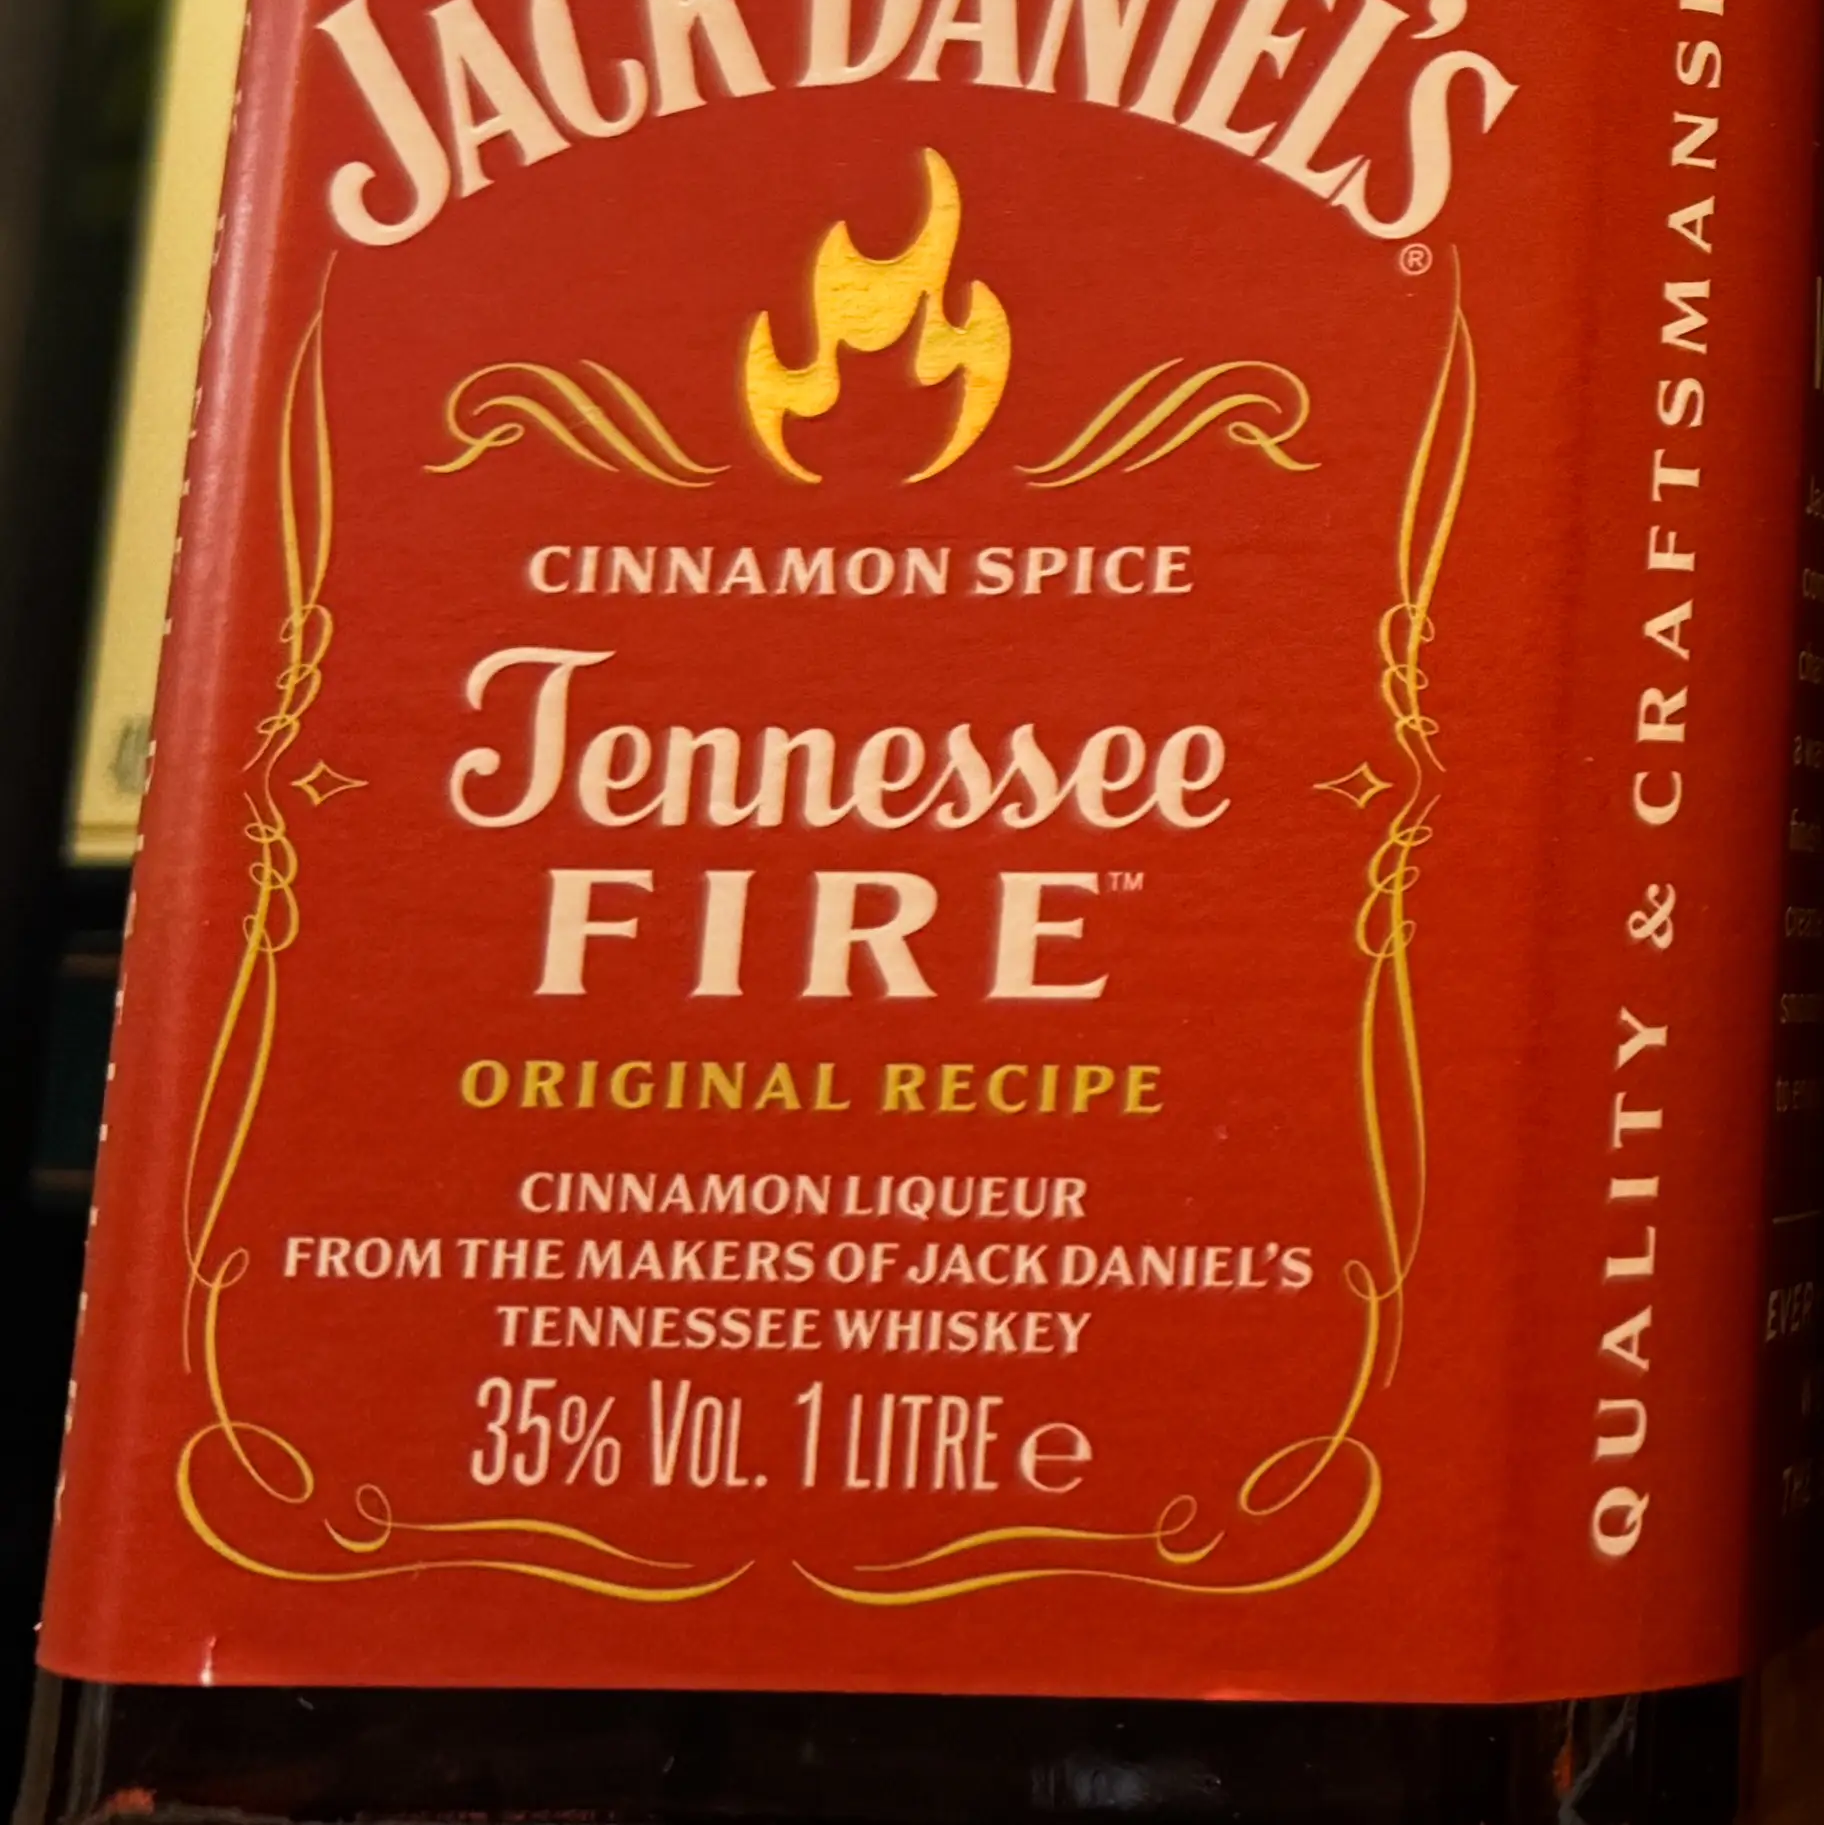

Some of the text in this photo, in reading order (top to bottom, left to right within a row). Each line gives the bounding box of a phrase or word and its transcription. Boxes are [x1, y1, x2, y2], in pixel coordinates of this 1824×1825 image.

[528, 546, 1191, 595] CINNAMON SPICE
[450, 647, 1229, 828] Tennessee
[1627, 882, 1677, 949] &
[461, 1060, 1161, 1113] ORIGINAL RECIPE
[520, 1172, 1085, 1220] CINNAMON LIQUEUR
[285, 1238, 1311, 1288] FROM THE MAKERS OF JACK DANIEL'S
[1591, 1006, 1669, 1557] QUALITY
[497, 1306, 1090, 1353] TENNESSEE WHISKEY
[471, 1377, 620, 1486] 35%
[798, 1382, 822, 1487] 1
[846, 1394, 1003, 1490] LITRE
